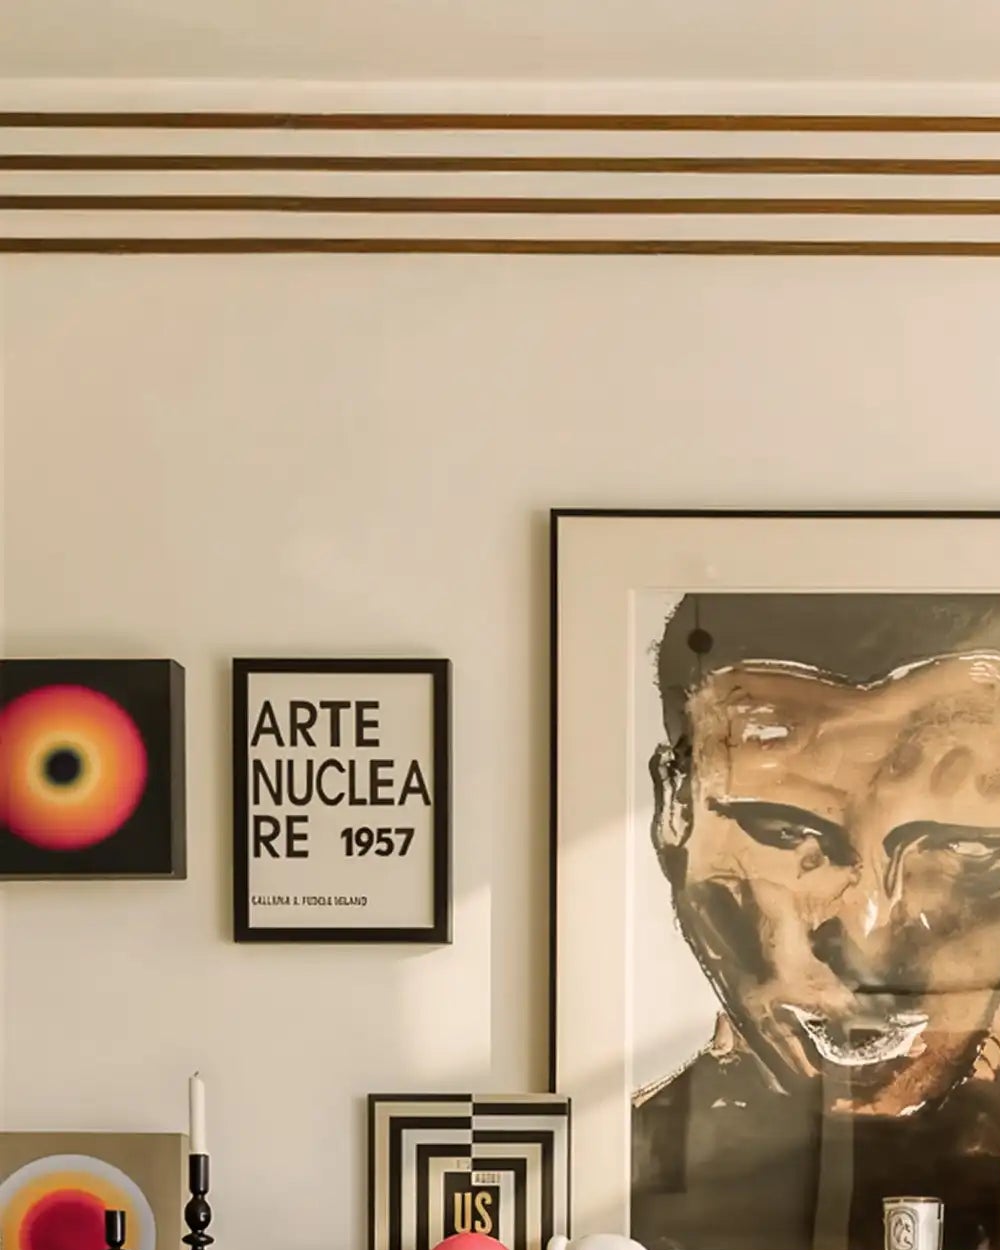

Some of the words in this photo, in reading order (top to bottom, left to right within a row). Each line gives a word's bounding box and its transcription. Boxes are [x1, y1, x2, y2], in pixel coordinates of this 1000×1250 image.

[251, 700, 380, 747] ARTE
[252, 758, 431, 806] NUCLEA
[253, 814, 309, 858] RE
[340, 826, 415, 857] 1957
[454, 1191, 493, 1234] US
